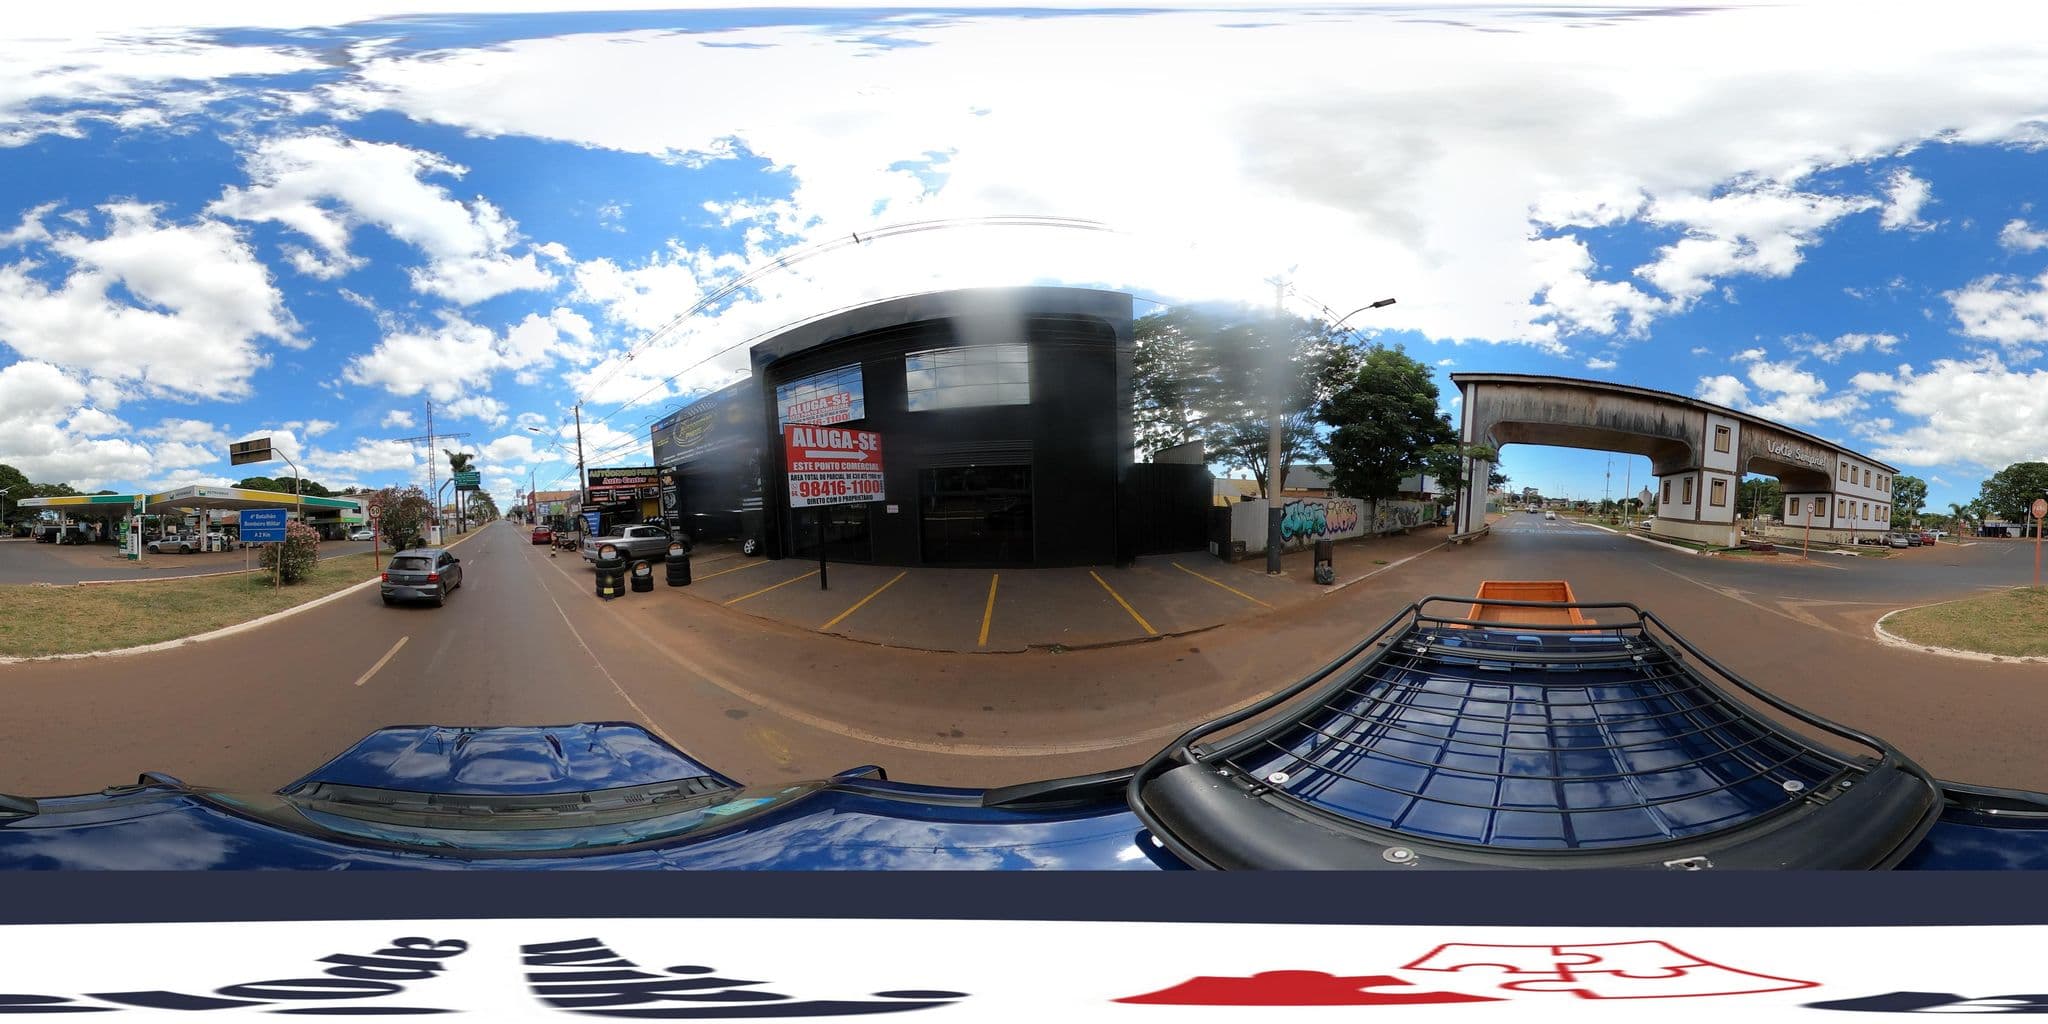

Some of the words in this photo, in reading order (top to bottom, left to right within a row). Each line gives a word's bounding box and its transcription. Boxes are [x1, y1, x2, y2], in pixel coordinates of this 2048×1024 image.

[790, 393, 849, 416] ALUGA-SE
[792, 427, 877, 451] ALUGA-SE
[1767, 439, 1792, 458] Volte
[1795, 448, 1827, 467] Sempre!
[793, 461, 814, 471] ESTE
[815, 461, 840, 471] PONTO
[841, 461, 880, 471] COMERCIAL
[602, 477, 623, 485] Auto
[622, 476, 647, 484] Center
[799, 480, 880, 498] 98416-1100
[807, 497, 825, 505] DIRETO
